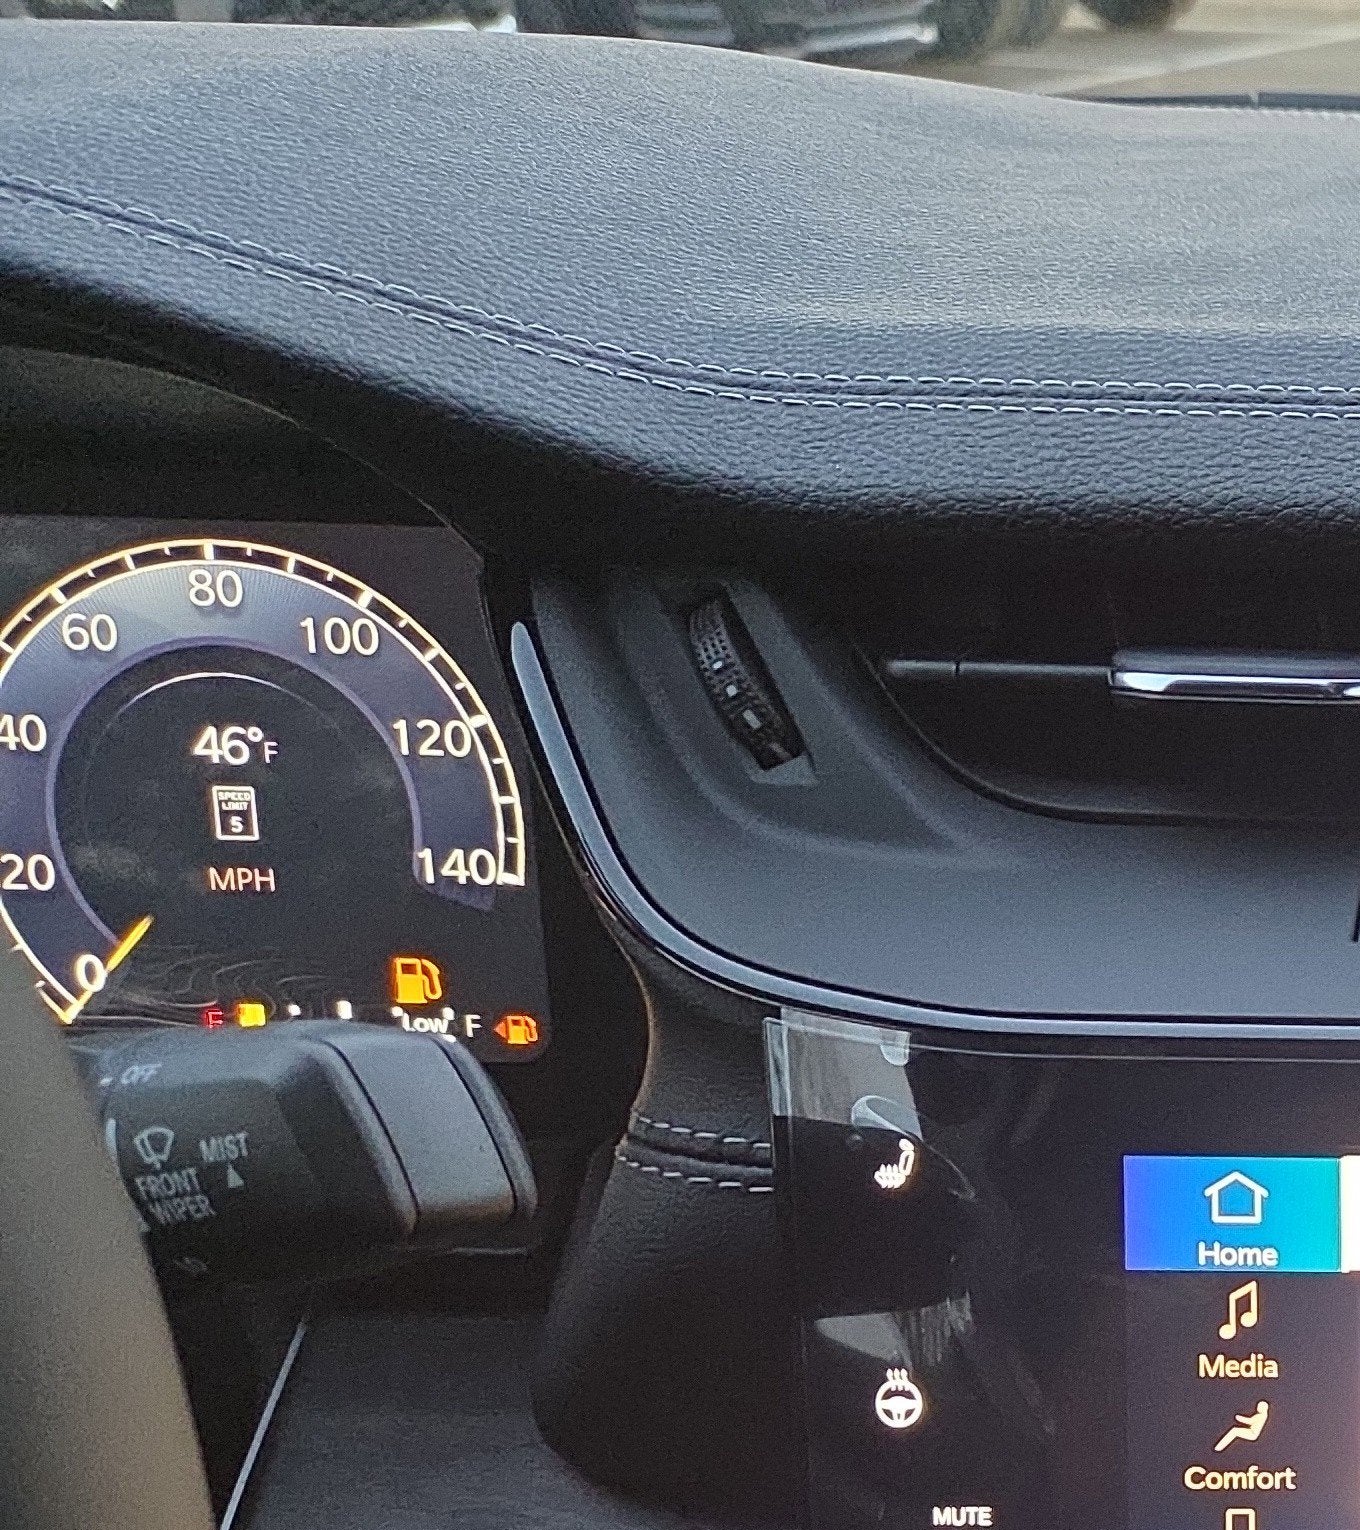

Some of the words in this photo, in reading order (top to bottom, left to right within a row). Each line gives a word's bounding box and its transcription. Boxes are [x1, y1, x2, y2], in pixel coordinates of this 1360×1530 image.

[188, 568, 243, 608] 80
[61, 613, 117, 652] 60
[300, 616, 379, 657] 100
[0, 714, 47, 753] 40
[392, 718, 472, 758] 120
[217, 791, 251, 801] SPEED
[221, 801, 248, 811] LIMIT
[0, 852, 55, 892] 20
[208, 867, 276, 893] MPH
[416, 848, 496, 886] 140
[74, 953, 108, 992] 0
[465, 1014, 483, 1038] F
[199, 1132, 249, 1162] MIST
[134, 1167, 201, 1201] FRONT
[149, 1195, 216, 1226] WIPER
[1195, 1240, 1279, 1268] Home
[1197, 1353, 1279, 1379] Media
[1183, 1464, 1297, 1491] Comfort
[932, 1506, 994, 1527] MUTE
